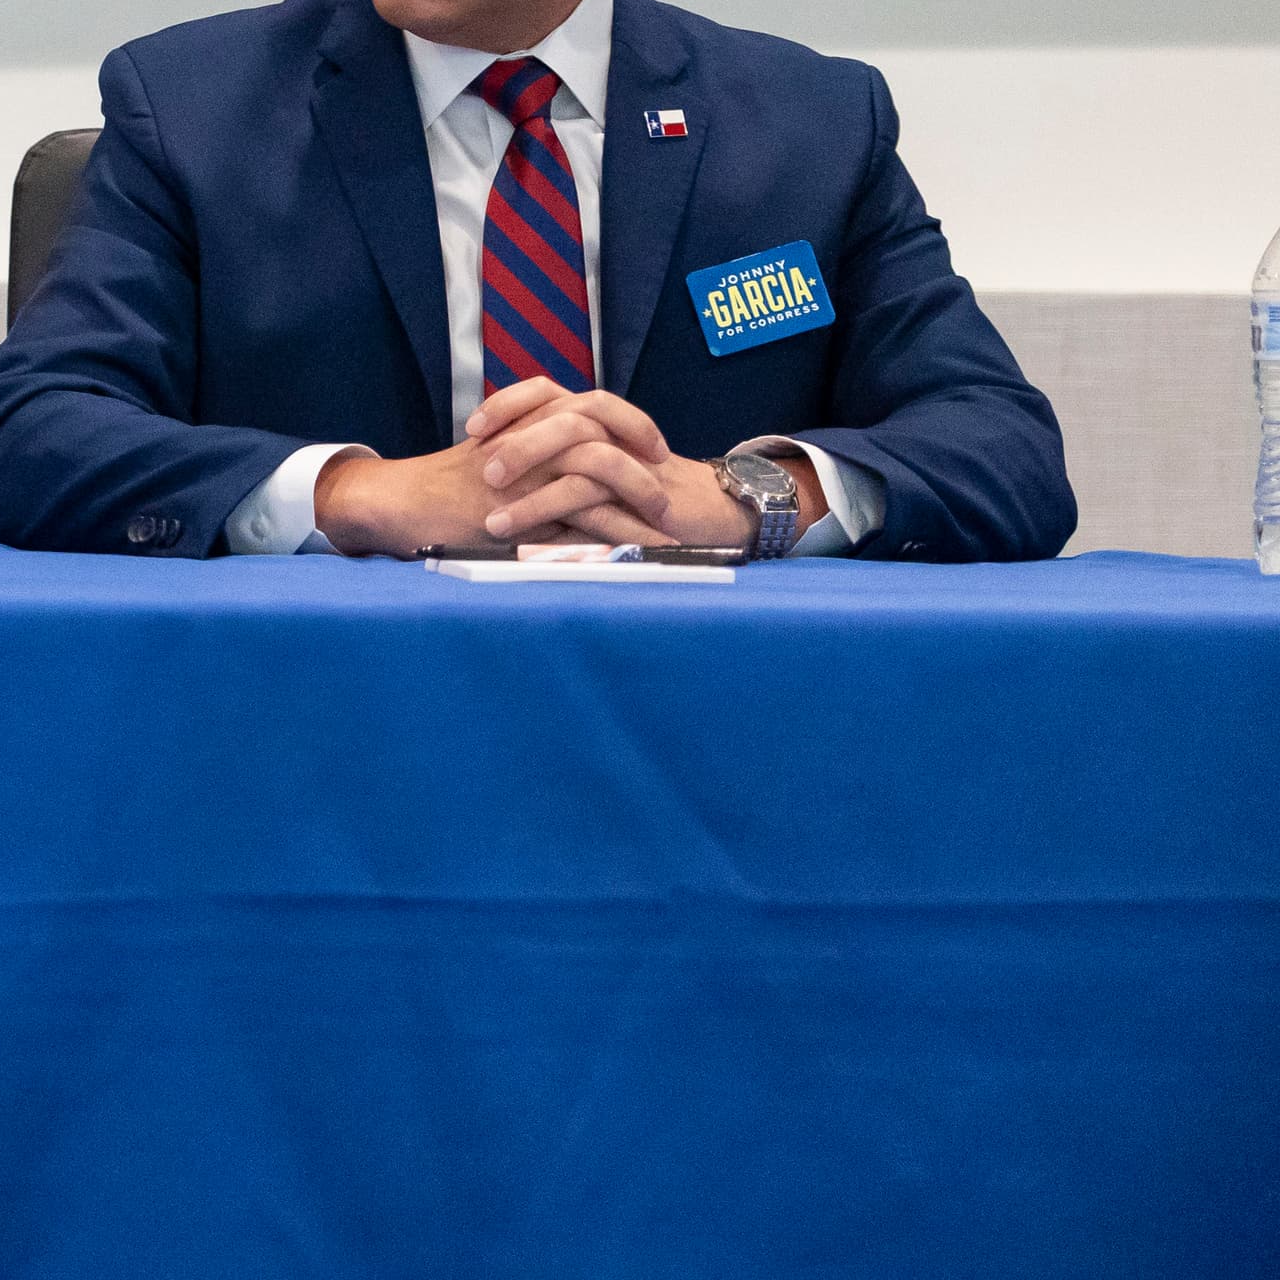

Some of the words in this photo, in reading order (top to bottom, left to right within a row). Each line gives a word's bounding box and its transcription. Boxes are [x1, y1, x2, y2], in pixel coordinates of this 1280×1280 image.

[718, 259, 786, 288] JOHNNY
[707, 266, 814, 328] GARCIA
[717, 326, 744, 339] FOR
[749, 303, 820, 330] CONGRESS
